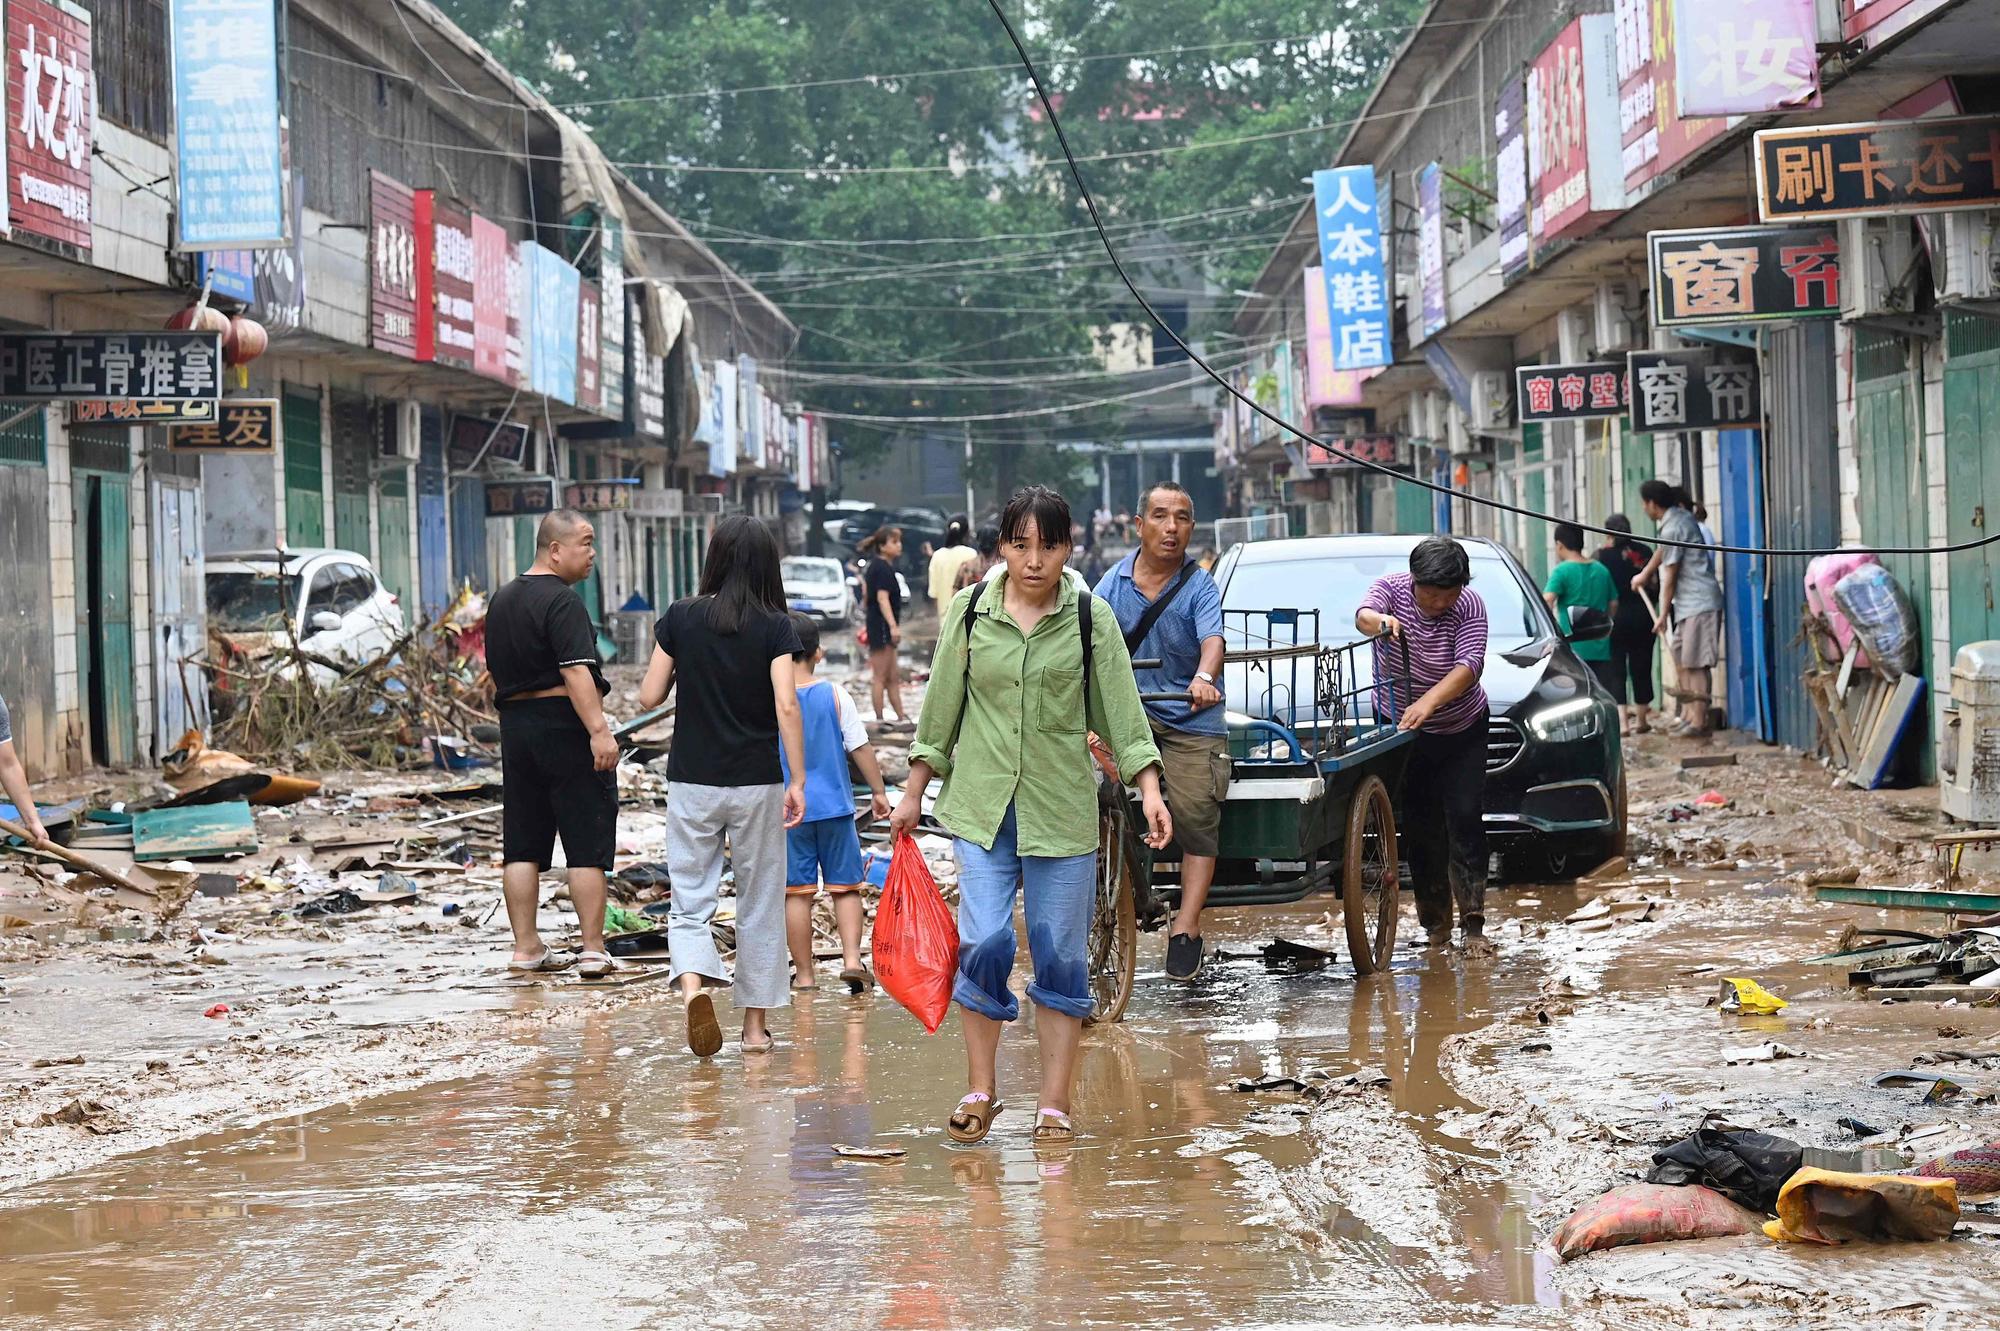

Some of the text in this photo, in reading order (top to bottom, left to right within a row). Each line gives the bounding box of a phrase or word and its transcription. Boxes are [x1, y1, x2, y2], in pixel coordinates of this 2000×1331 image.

[1696, 21, 1806, 97] 妆
[1323, 176, 1384, 368] 人本鞋店
[1662, 235, 1840, 317] 窗帘
[1525, 371, 1630, 413] 窗帘壁
[1638, 359, 1754, 426] 窗帘
